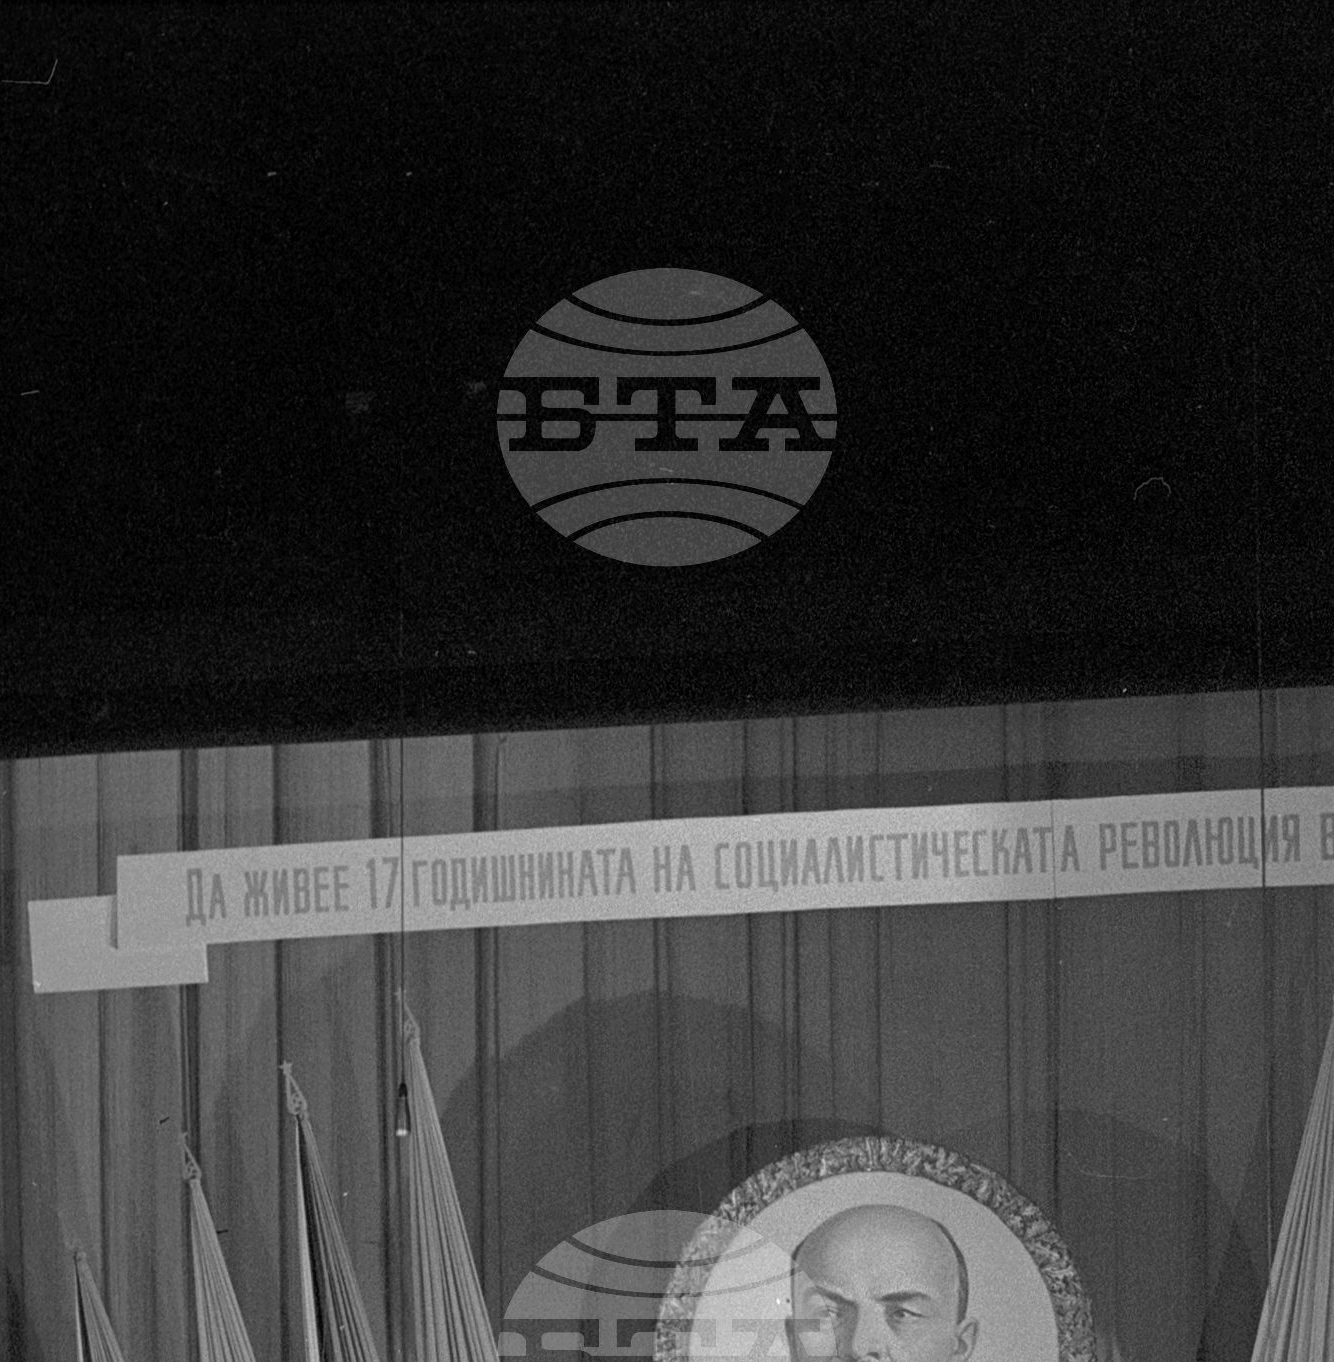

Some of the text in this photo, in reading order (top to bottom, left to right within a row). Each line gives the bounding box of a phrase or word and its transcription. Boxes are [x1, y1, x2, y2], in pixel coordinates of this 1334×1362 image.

[186, 867, 227, 927] ДА
[243, 865, 350, 917] ЖИВЕЕ
[367, 856, 399, 909] 17
[412, 847, 637, 911] ГОДИШНИНАТА
[653, 845, 696, 893] НА
[715, 825, 1080, 892] СОЦИАЛИСТИЧЕСКАТА
[1099, 813, 1301, 870] РЕВОЛЮЦИЯ
